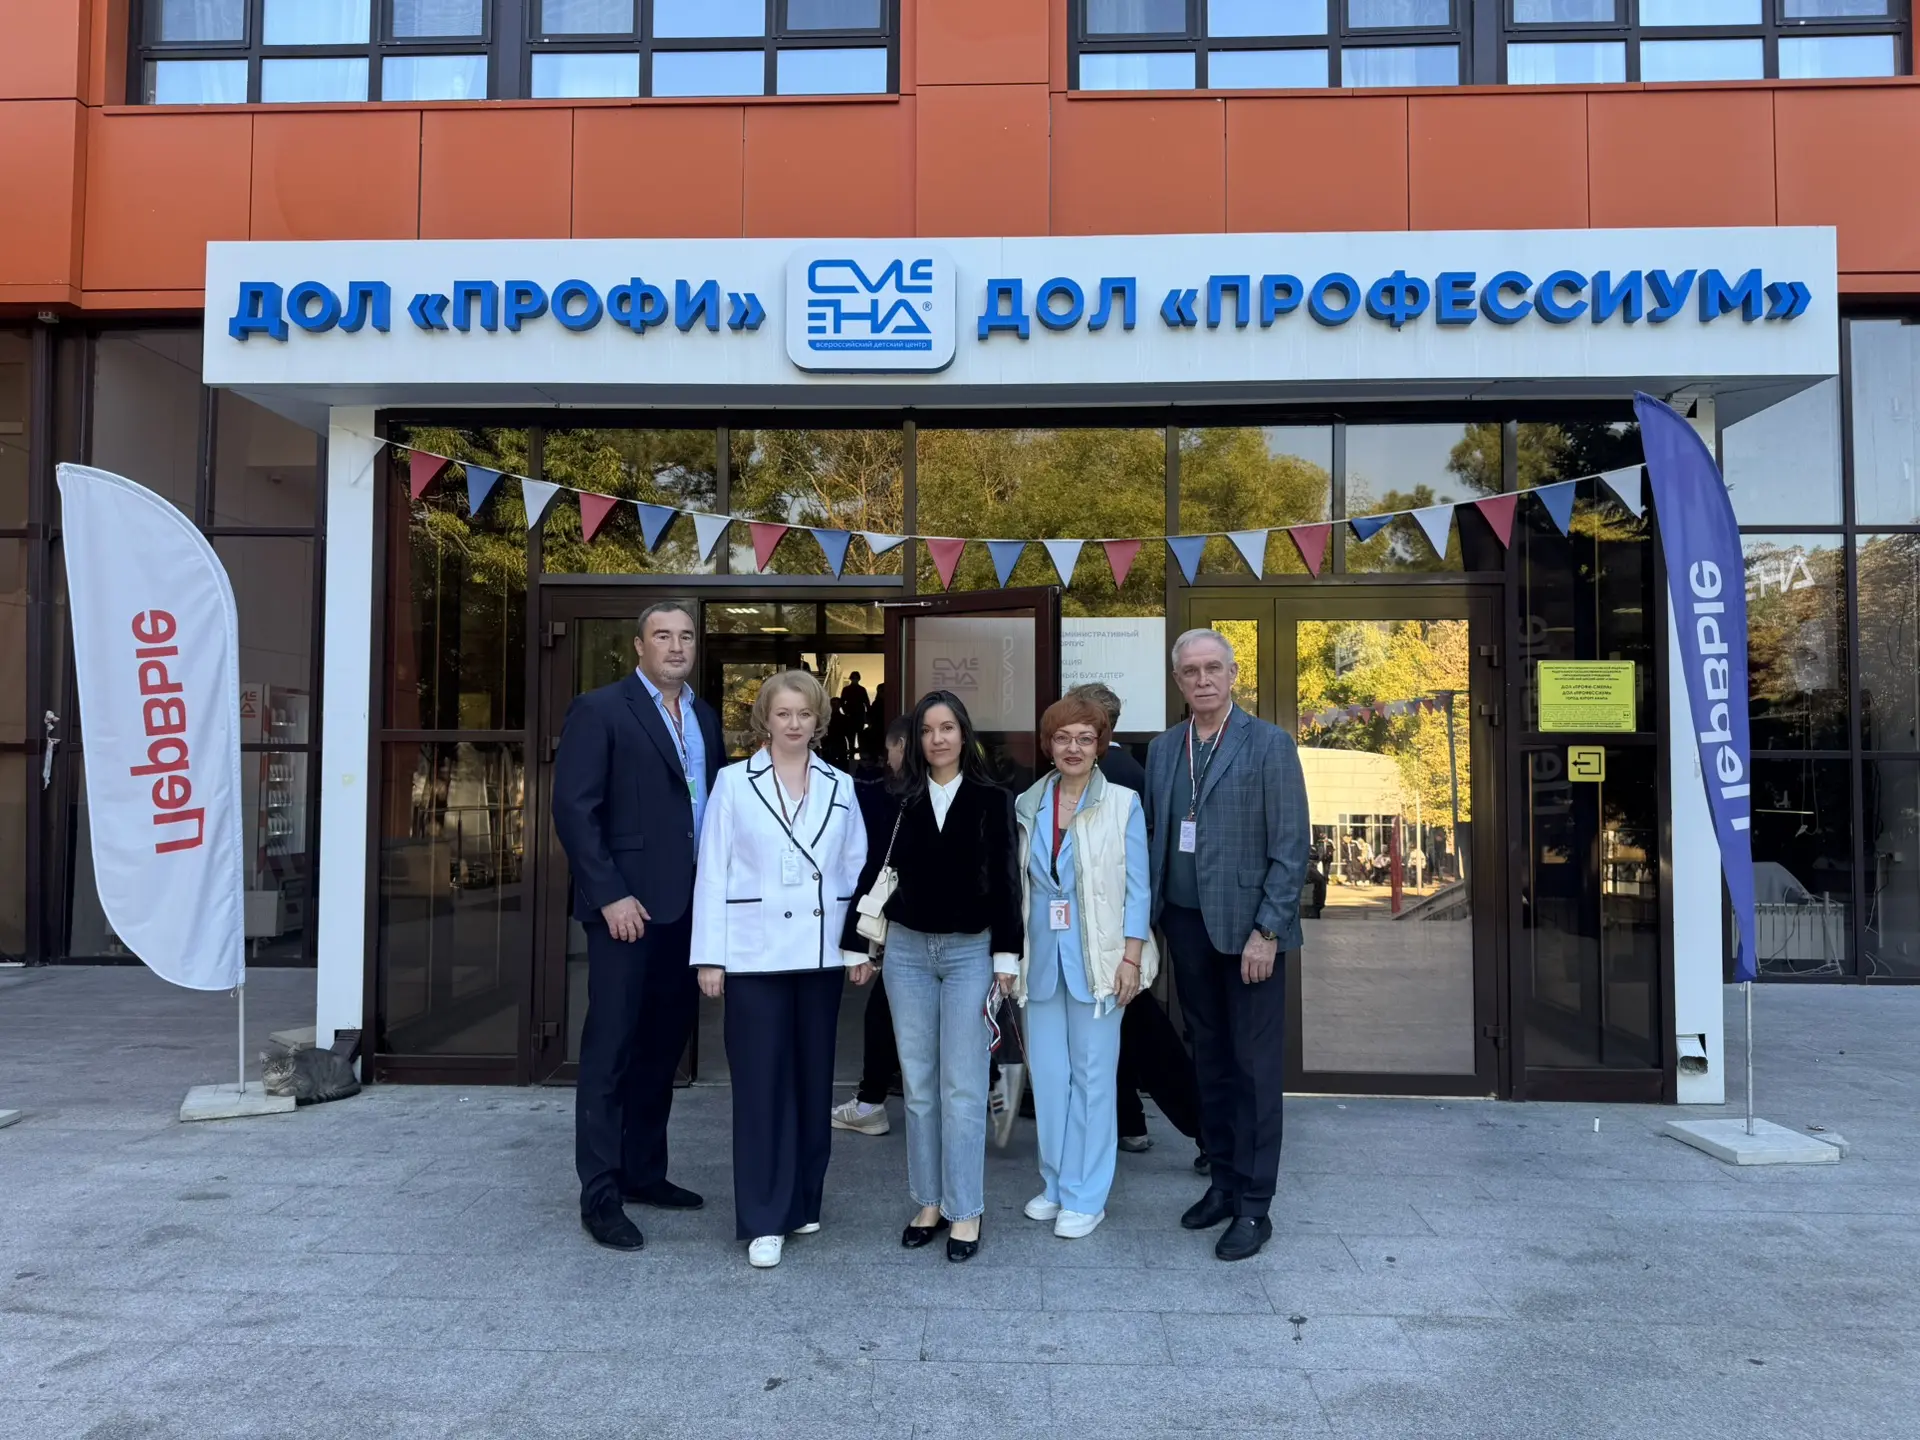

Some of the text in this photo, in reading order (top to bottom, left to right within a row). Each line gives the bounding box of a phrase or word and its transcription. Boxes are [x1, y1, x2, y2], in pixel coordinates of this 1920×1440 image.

[229, 277, 766, 341] ДОЛ «ПРОФИ»
[978, 269, 1812, 340] ДОЛ «ПРОФЕССИУМ»
[1079, 671, 1125, 679] БУХГАЛТЕР
